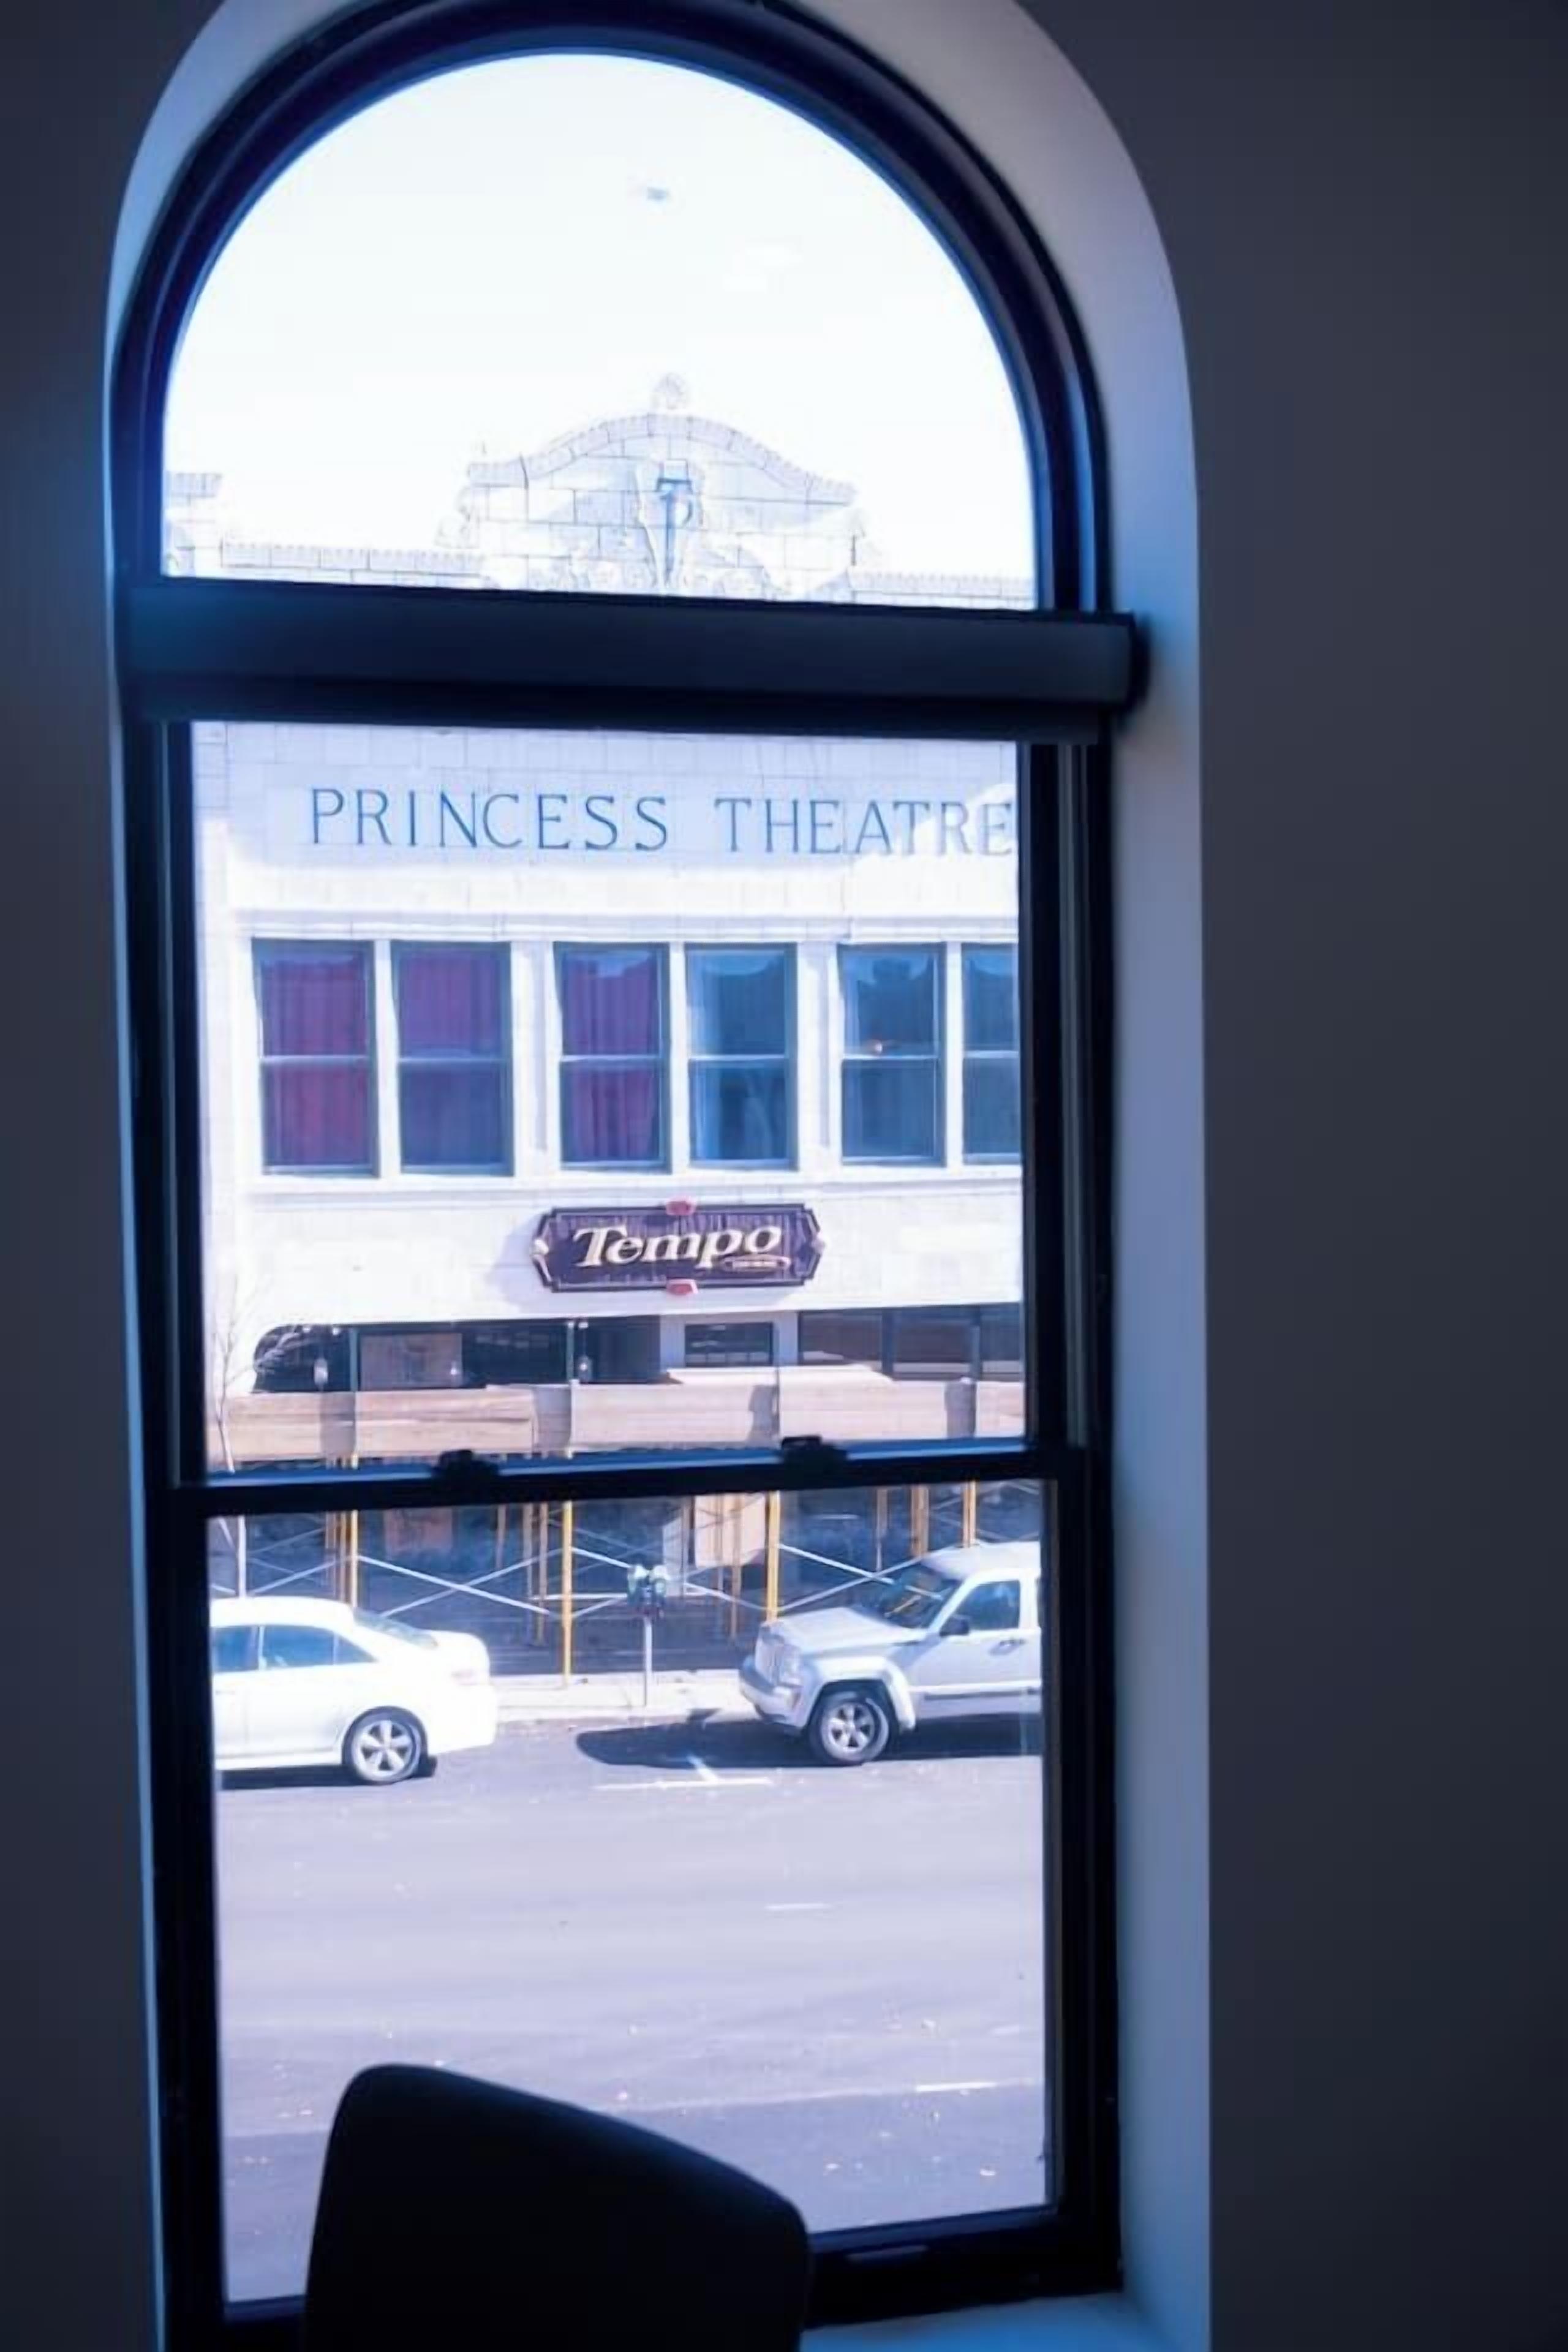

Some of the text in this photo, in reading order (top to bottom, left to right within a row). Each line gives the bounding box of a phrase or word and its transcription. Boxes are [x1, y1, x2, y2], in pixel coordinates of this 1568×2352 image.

[312, 788, 1012, 856] PRINCESS THEATRE
[573, 1224, 782, 1270] Tempo
